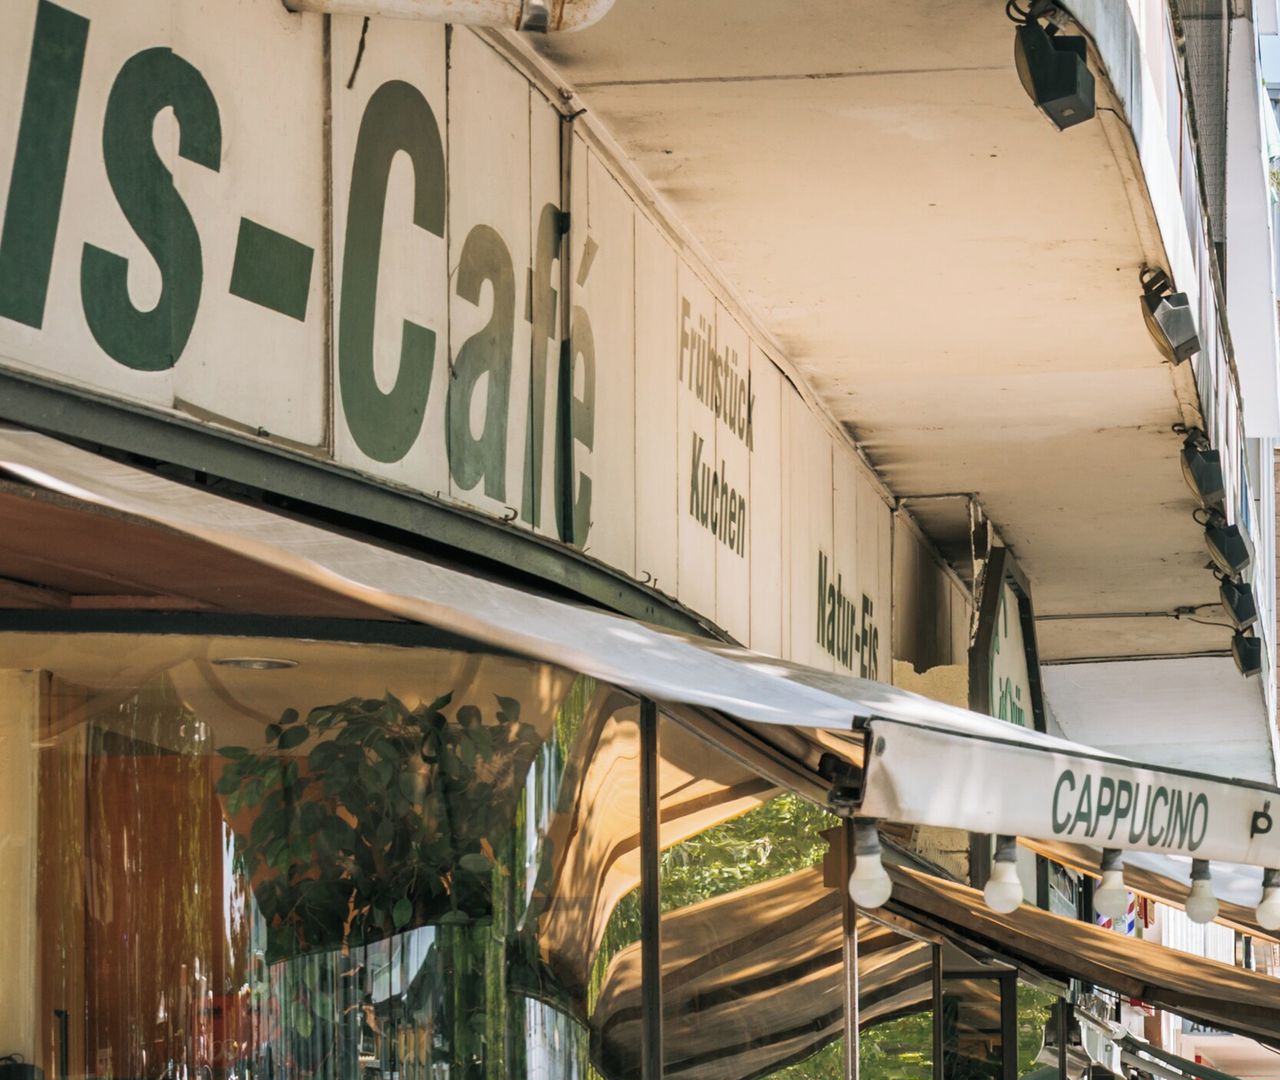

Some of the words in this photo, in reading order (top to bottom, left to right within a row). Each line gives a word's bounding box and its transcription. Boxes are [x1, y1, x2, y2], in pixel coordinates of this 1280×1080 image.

[678, 296, 754, 452] Frühstück
[689, 431, 746, 558] Kuchen
[816, 549, 880, 683] Natur-Eis
[1051, 768, 1210, 852] CAPPUCINO
